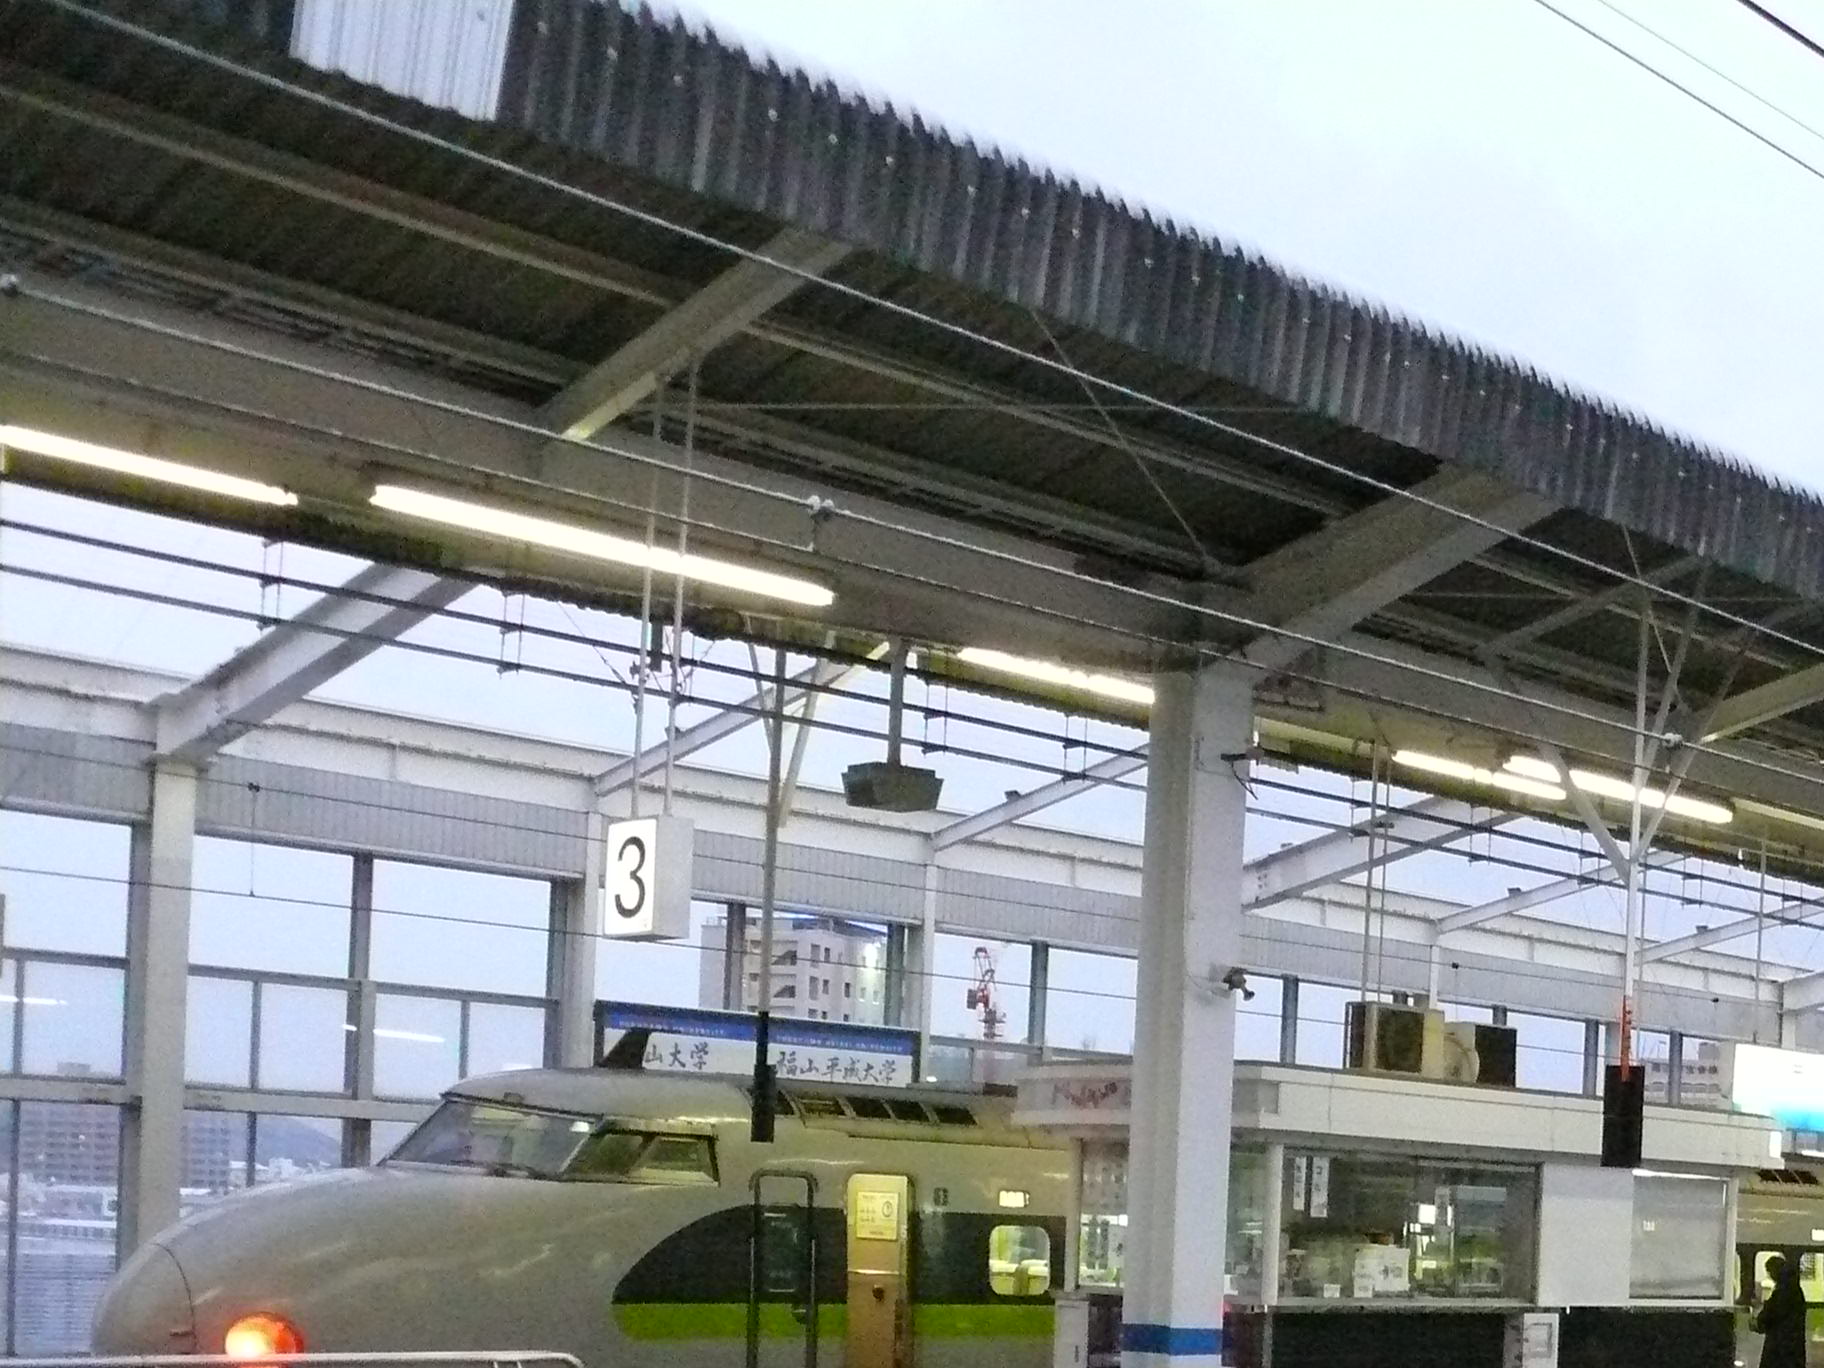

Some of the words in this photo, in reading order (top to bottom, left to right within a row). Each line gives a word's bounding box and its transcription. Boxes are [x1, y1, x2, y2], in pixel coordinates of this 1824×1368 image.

[614, 836, 646, 918] 3
[644, 1042, 709, 1070] 山大学
[777, 1050, 897, 1086] 福山平成大学
